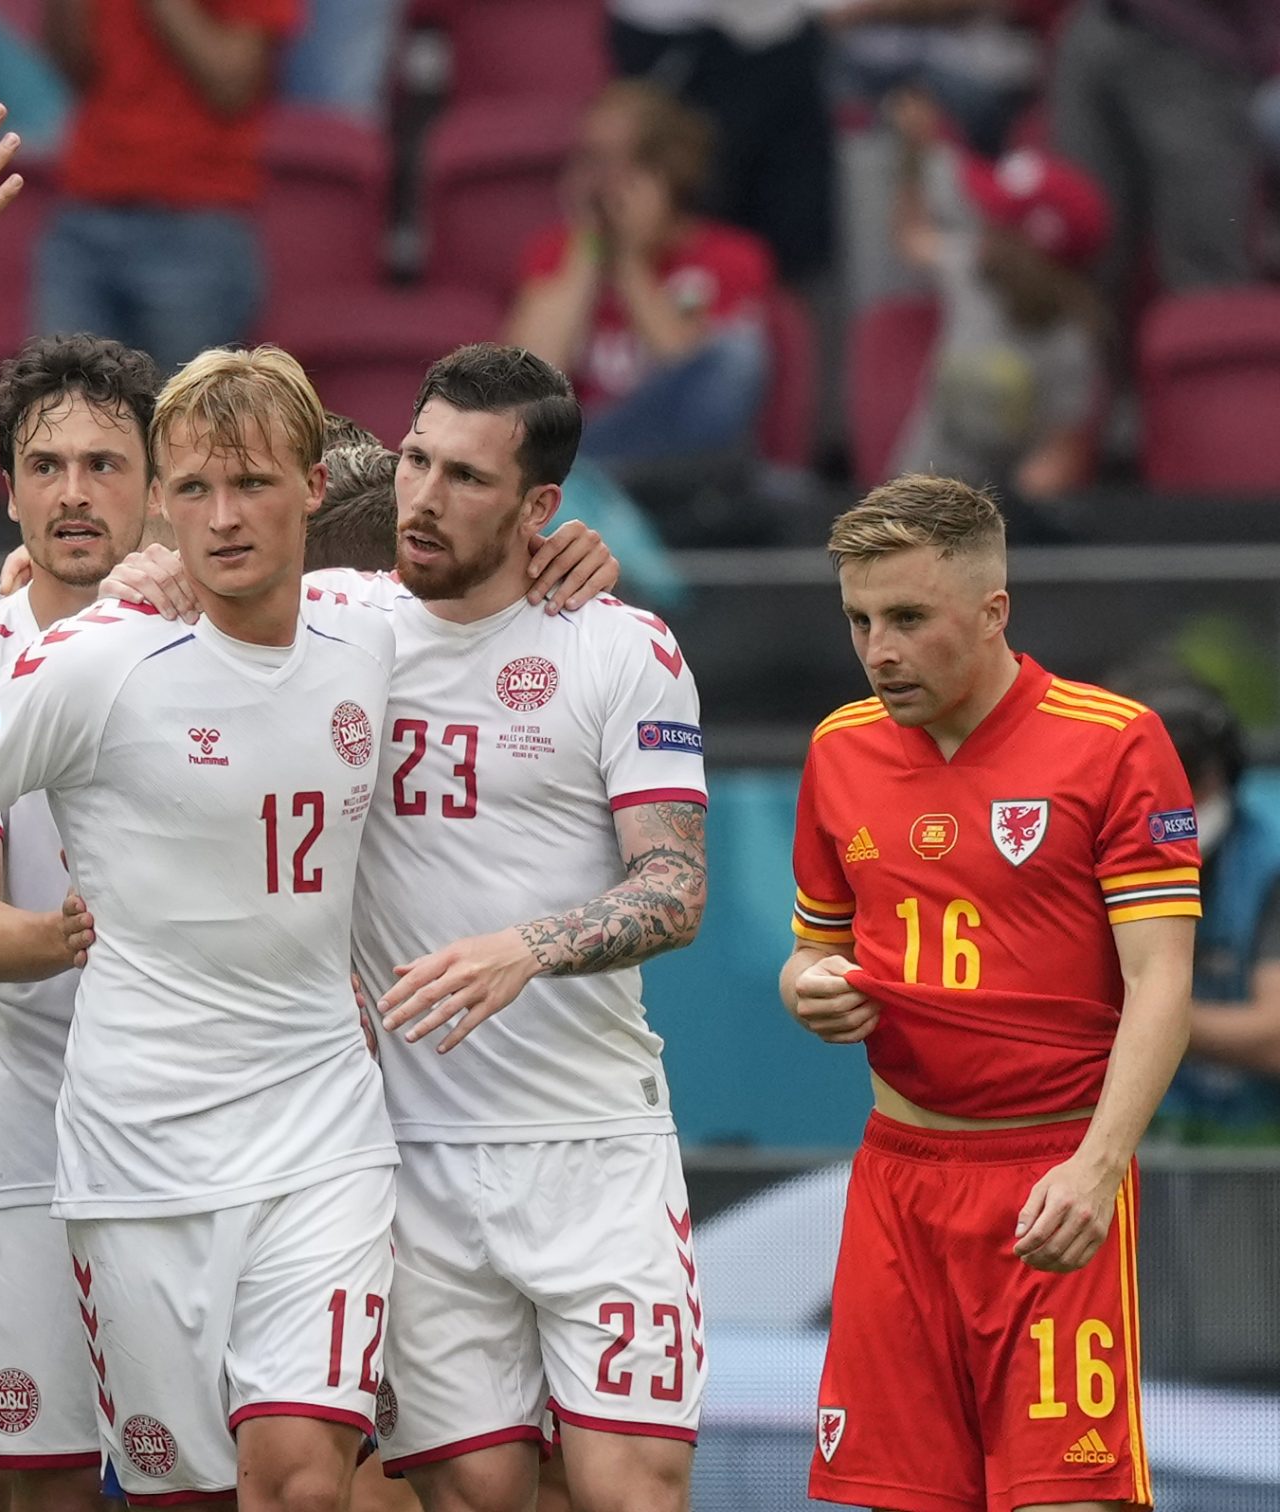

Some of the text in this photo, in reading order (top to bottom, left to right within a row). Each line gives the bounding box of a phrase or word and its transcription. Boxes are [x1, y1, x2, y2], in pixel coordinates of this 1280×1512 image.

[508, 674, 546, 691] DBU
[340, 721, 366, 745] DBU
[662, 729, 703, 747] RESPECT
[188, 753, 229, 766] hummel
[392, 718, 479, 819] 23
[1164, 816, 1195, 834] RESPECT
[261, 791, 324, 894] 12
[845, 847, 879, 863] adidas
[896, 897, 981, 989] 16
[327, 1288, 384, 1394] 12
[596, 1302, 684, 1401] 23
[1029, 1317, 1116, 1419] 16
[132, 1435, 167, 1453] DBU
[1063, 1450, 1116, 1464] adidas
